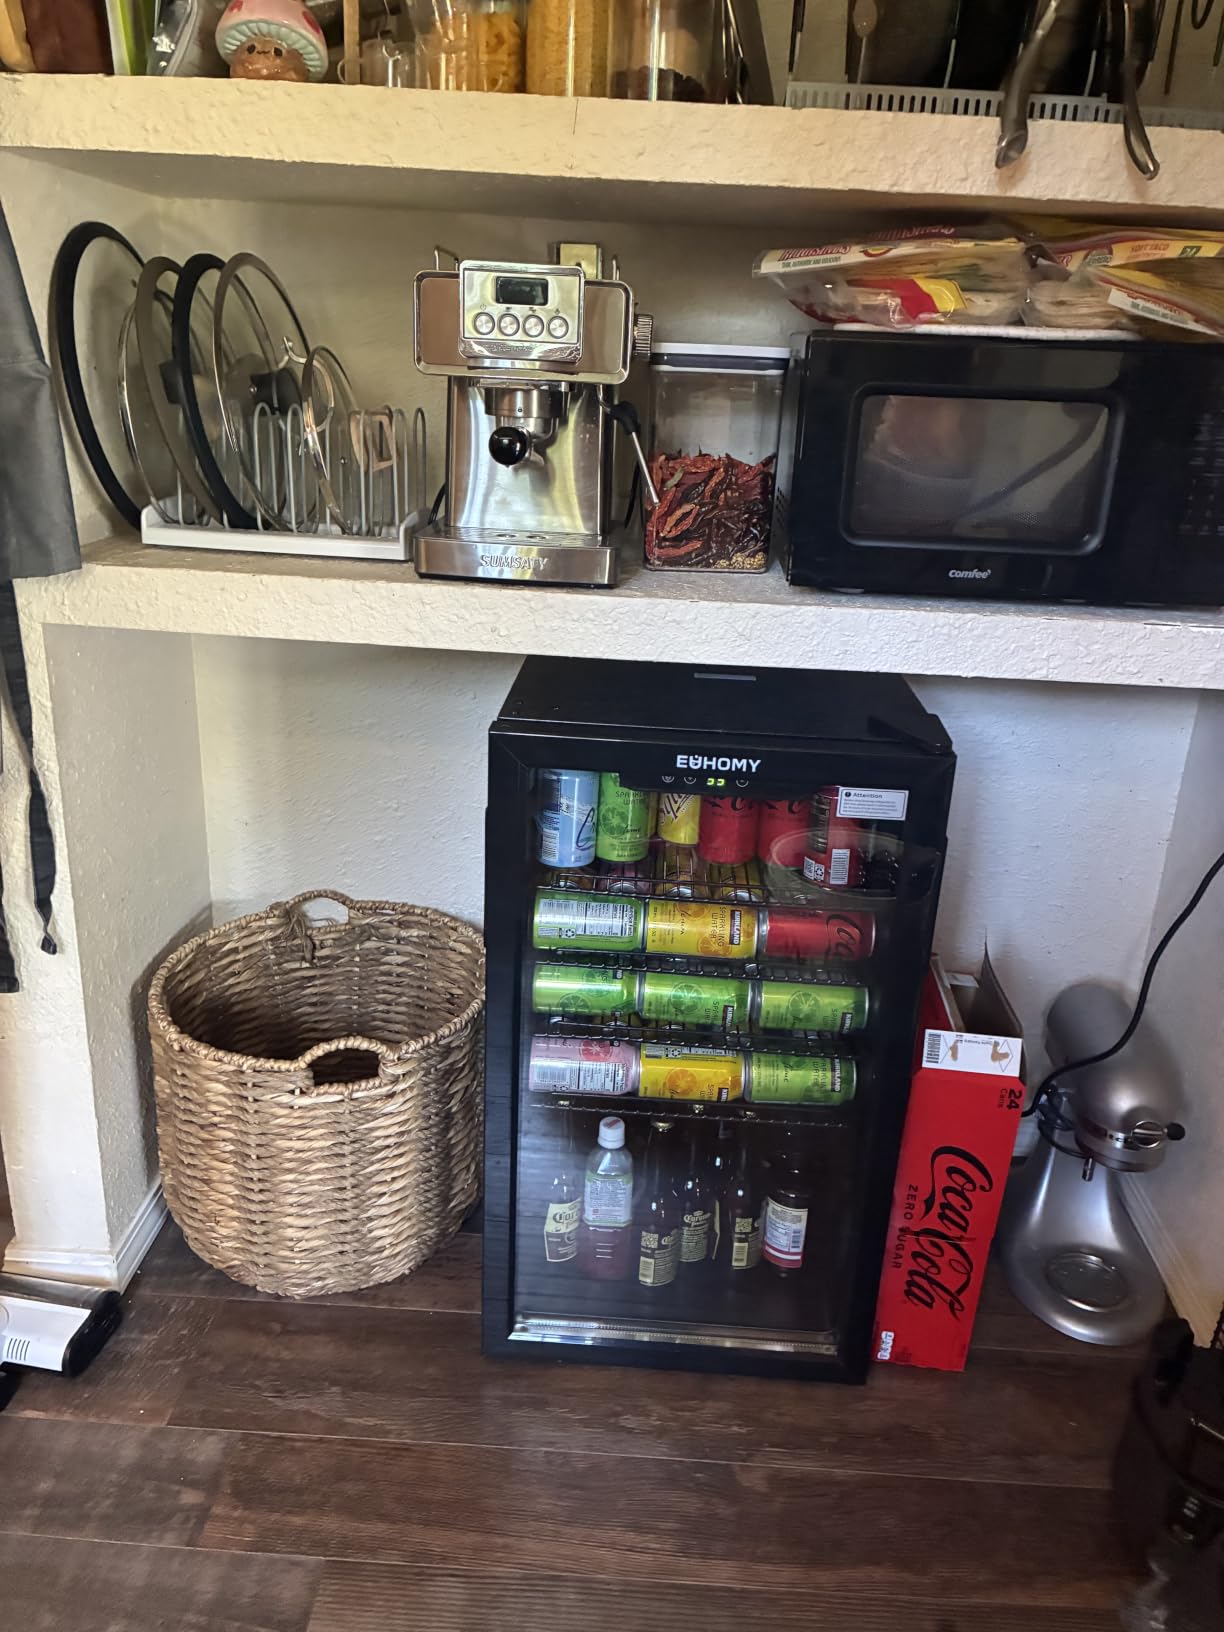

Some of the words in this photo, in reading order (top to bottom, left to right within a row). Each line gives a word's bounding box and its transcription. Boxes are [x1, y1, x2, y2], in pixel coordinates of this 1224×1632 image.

[676, 754, 761, 773] EUHOMY
[733, 910, 741, 945] KIRKLAND
[1006, 1088, 1022, 1110] 24
[904, 1184, 918, 1221] ZERO
[892, 1226, 912, 1269] SUGAR
